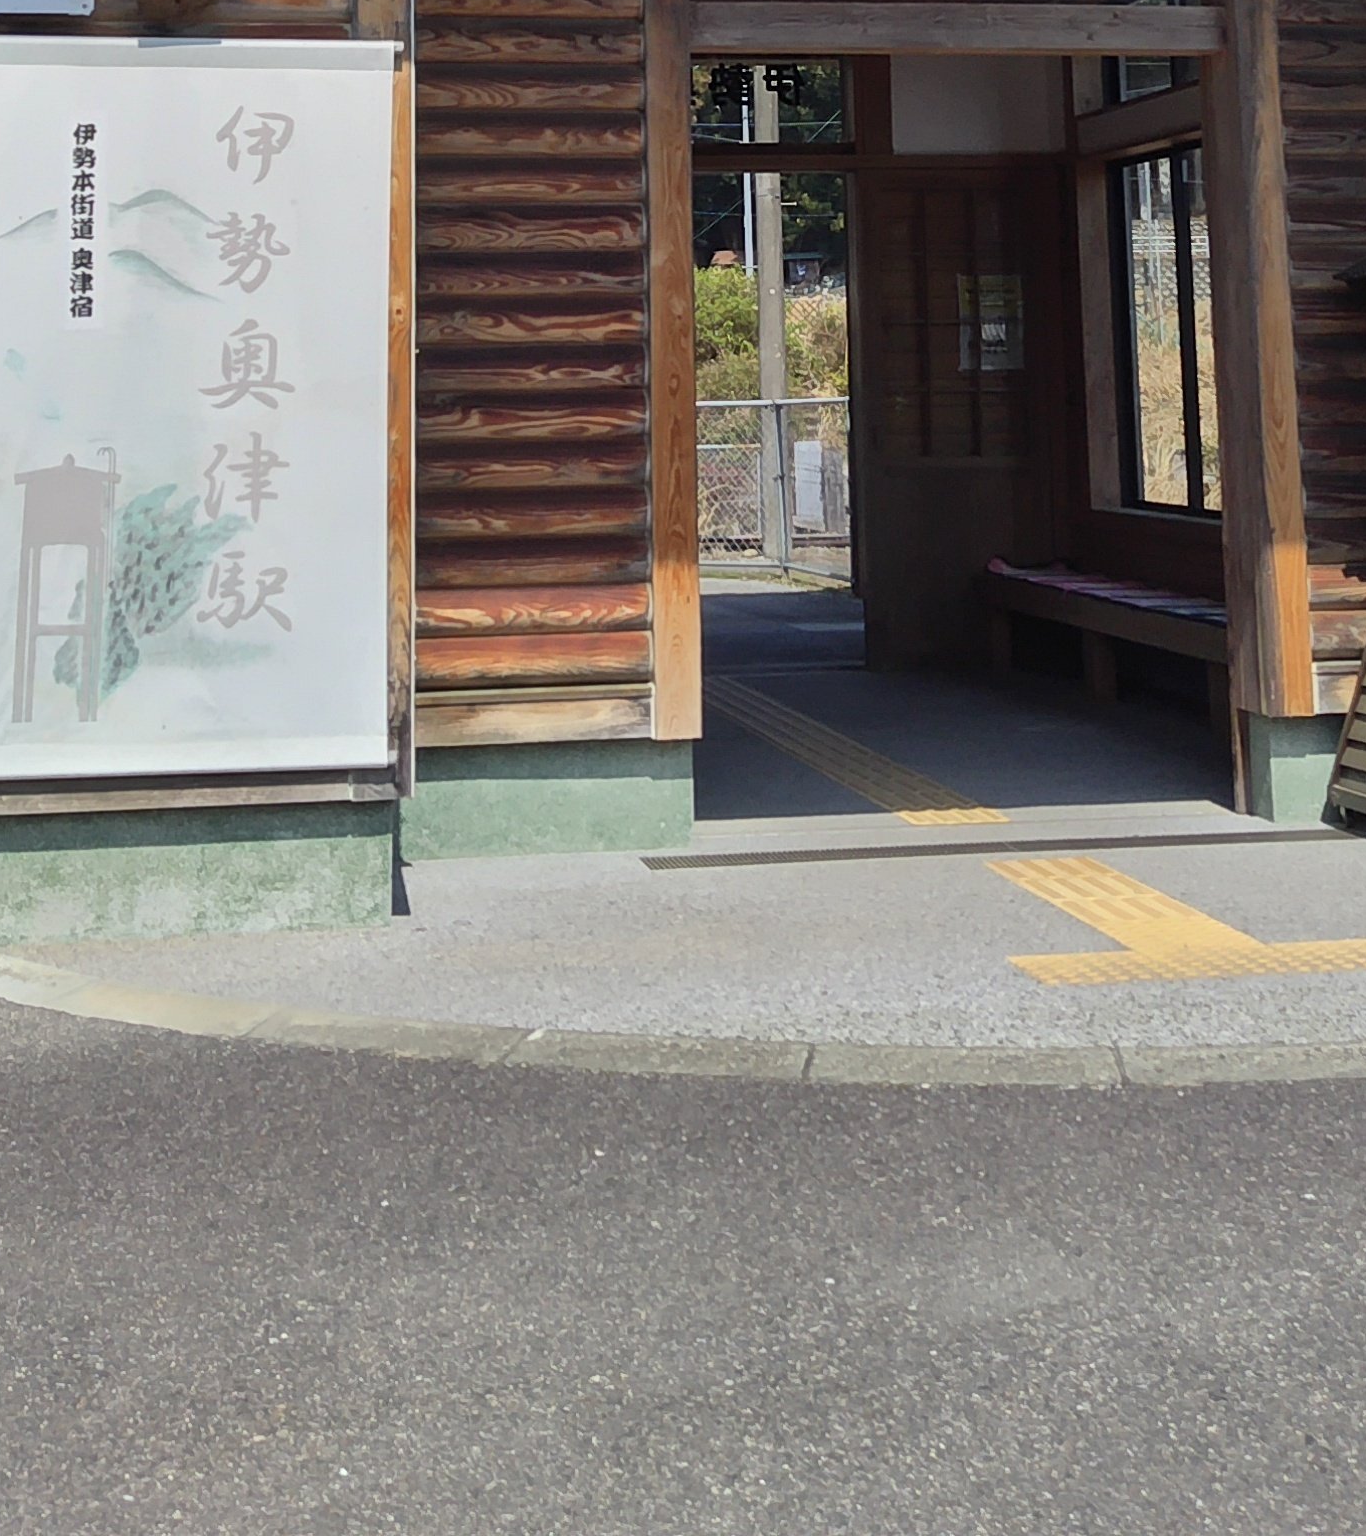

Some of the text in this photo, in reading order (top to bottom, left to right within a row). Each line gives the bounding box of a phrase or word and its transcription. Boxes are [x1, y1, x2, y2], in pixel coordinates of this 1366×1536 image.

[69, 123, 97, 319] 伊勢本街道 奥津宿
[197, 104, 296, 633] 伊勢奥津駅
